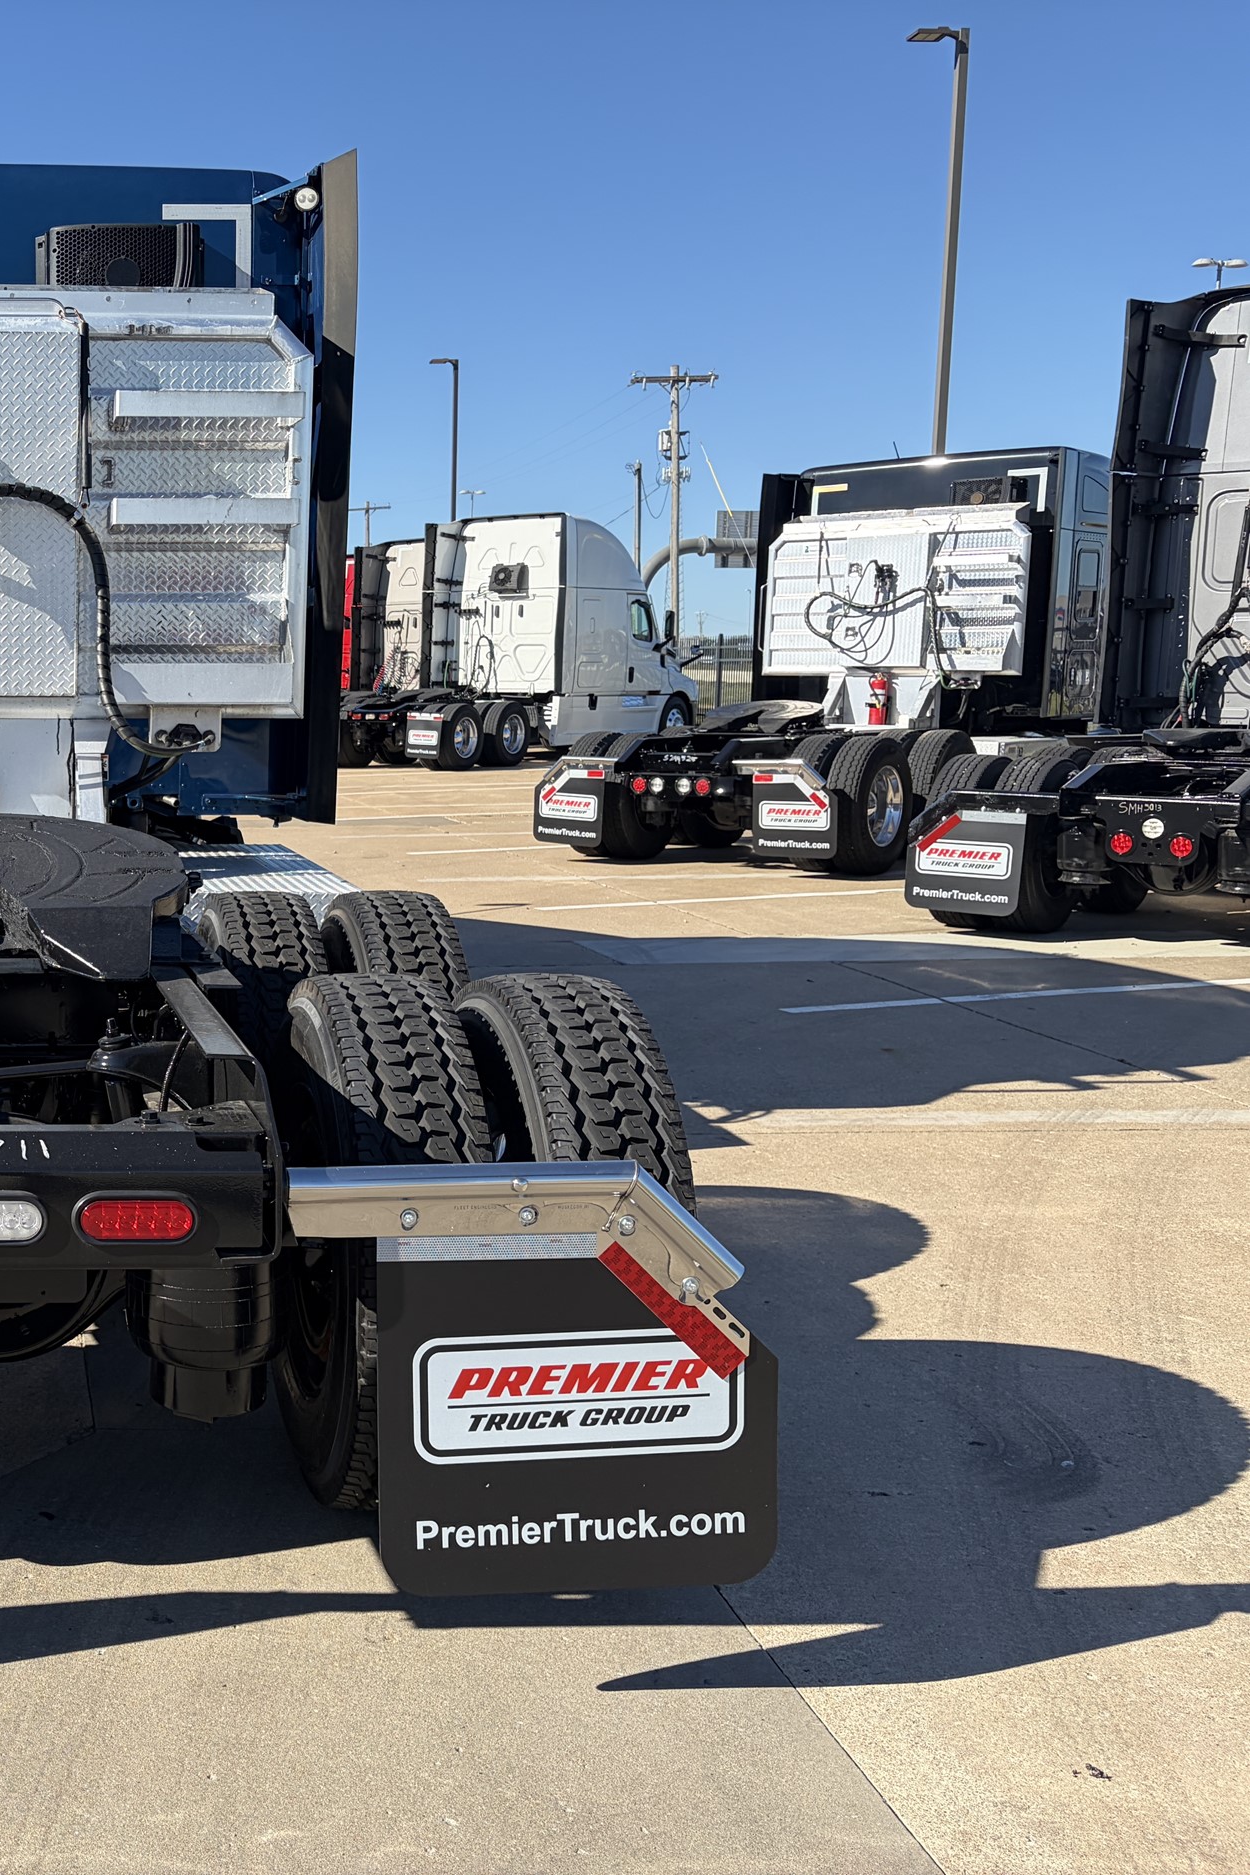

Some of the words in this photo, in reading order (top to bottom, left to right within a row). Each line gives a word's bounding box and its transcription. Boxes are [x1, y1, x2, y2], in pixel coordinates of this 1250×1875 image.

[547, 798, 591, 808] PREMIER
[766, 808, 822, 817] PREMIER
[537, 825, 597, 839] PremierTruck.com
[758, 838, 830, 850] PremierTruck.com
[926, 847, 1003, 861] PREMIER
[930, 860, 961, 868] TRUCK
[961, 862, 996, 870] GROUP
[912, 886, 1009, 904] PremierTruck.com
[447, 1357, 709, 1400] PREMIER
[467, 1409, 575, 1433] TRUCK
[579, 1404, 692, 1427] GROUP
[415, 1508, 747, 1551] PremierTruck.com
